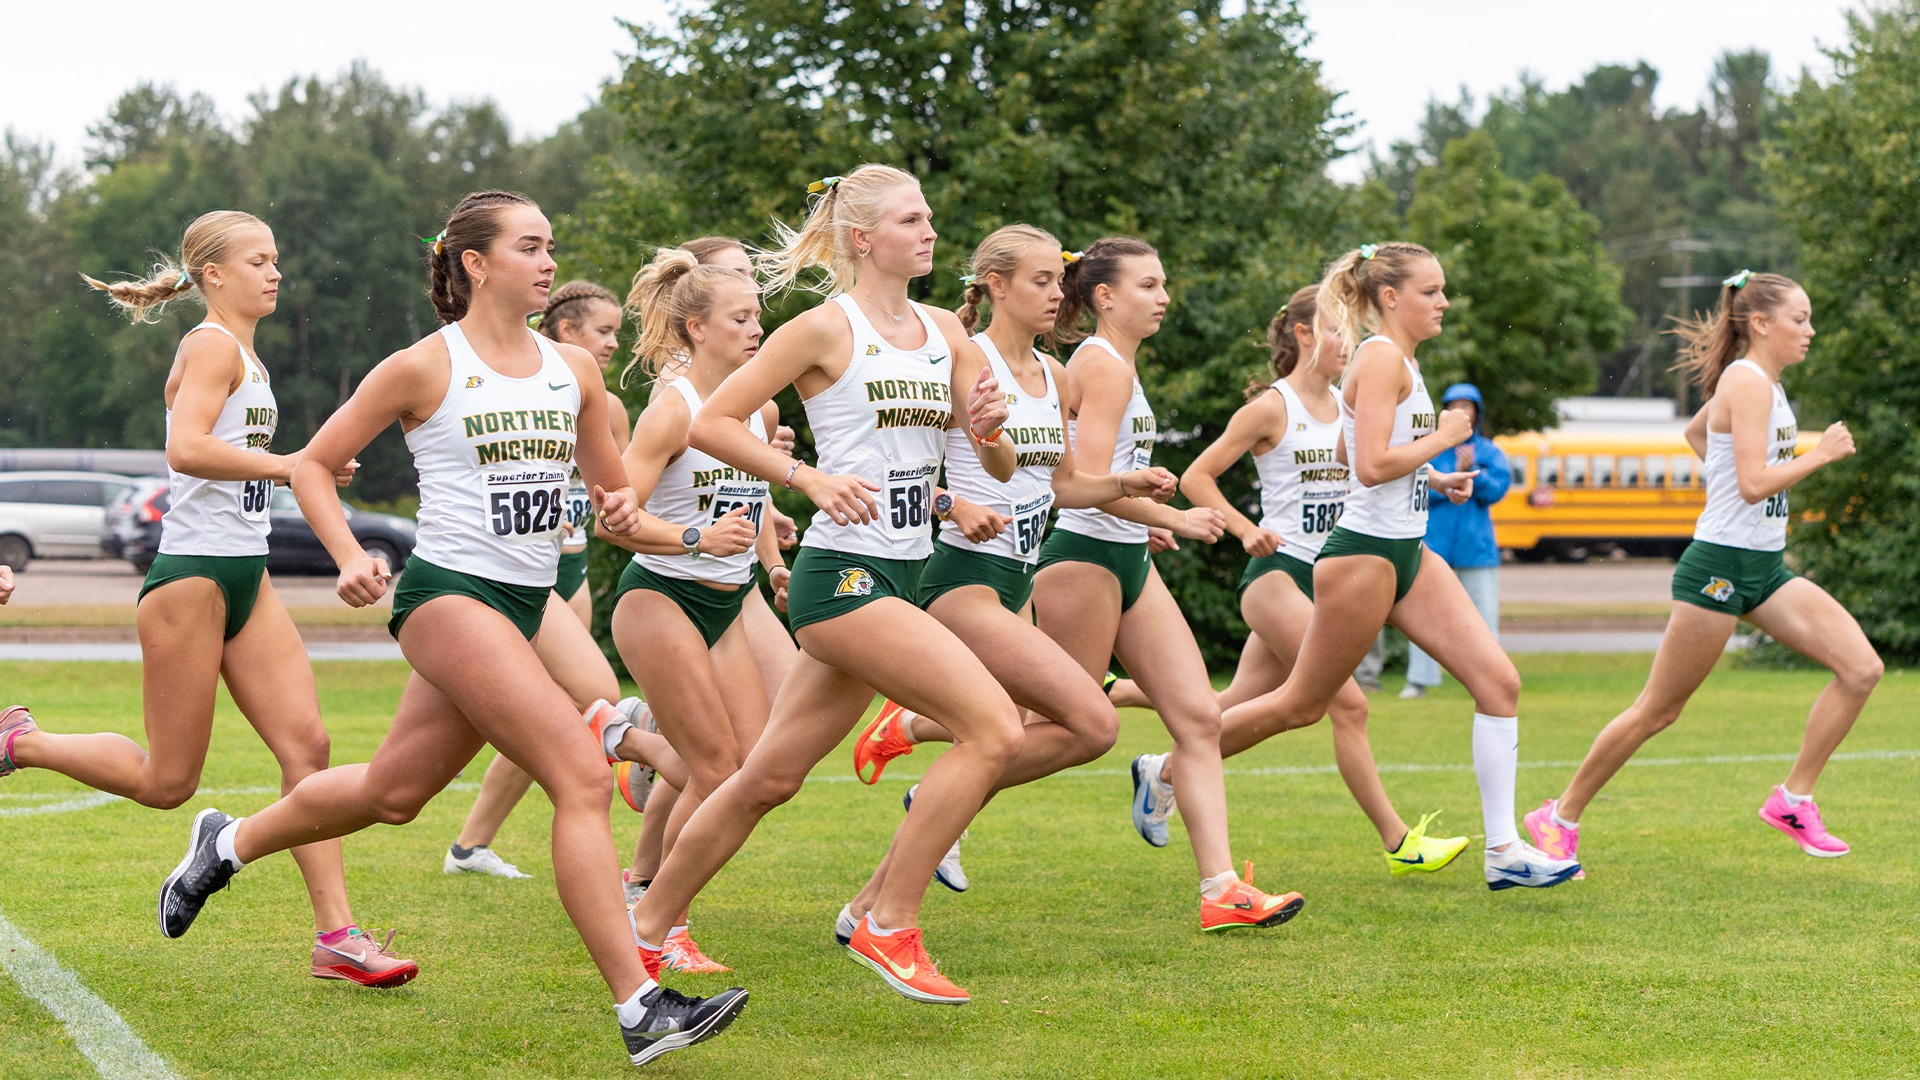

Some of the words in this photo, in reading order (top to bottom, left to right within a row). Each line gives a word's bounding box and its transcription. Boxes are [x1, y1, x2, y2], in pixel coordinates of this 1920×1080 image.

[864, 379, 950, 403] NORTHER
[462, 409, 577, 438] NORTHER
[1004, 426, 1065, 446] NORTHE
[488, 472, 537, 482] Superior
[719, 485, 750, 494] Superior
[490, 488, 563, 536] 5829
[1015, 499, 1042, 511] Superior
[1302, 502, 1345, 534] 5837
